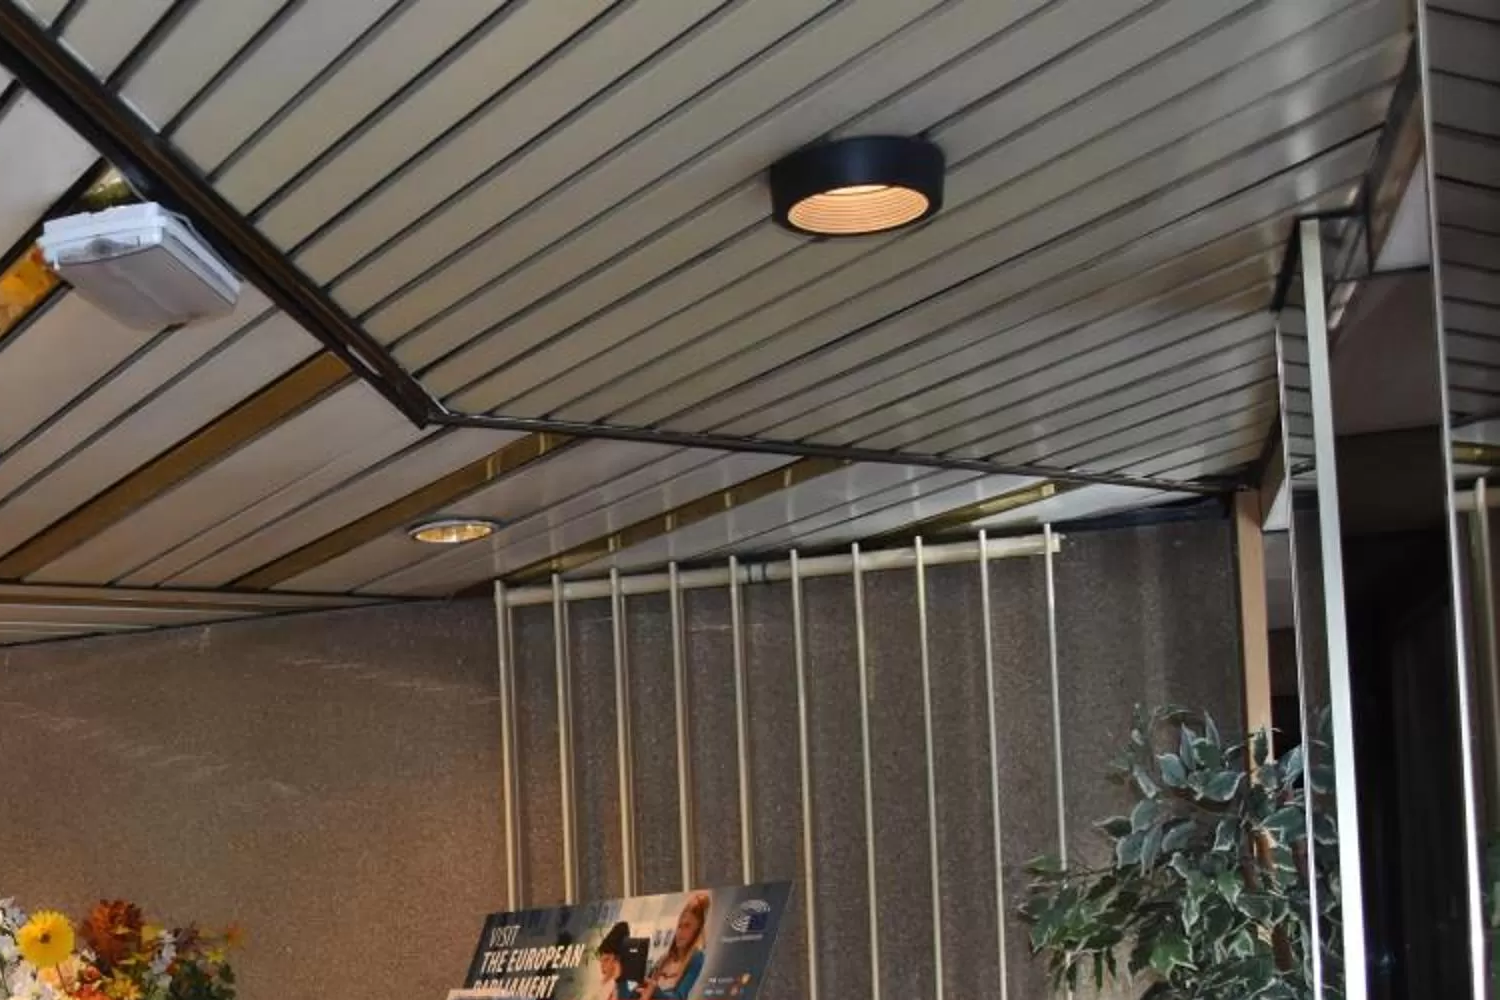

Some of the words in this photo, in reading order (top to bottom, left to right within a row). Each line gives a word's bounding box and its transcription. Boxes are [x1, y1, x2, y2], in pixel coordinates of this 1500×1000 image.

[489, 925, 520, 948] VISIT
[481, 950, 508, 973] THE
[506, 943, 585, 973] EUROPEAN
